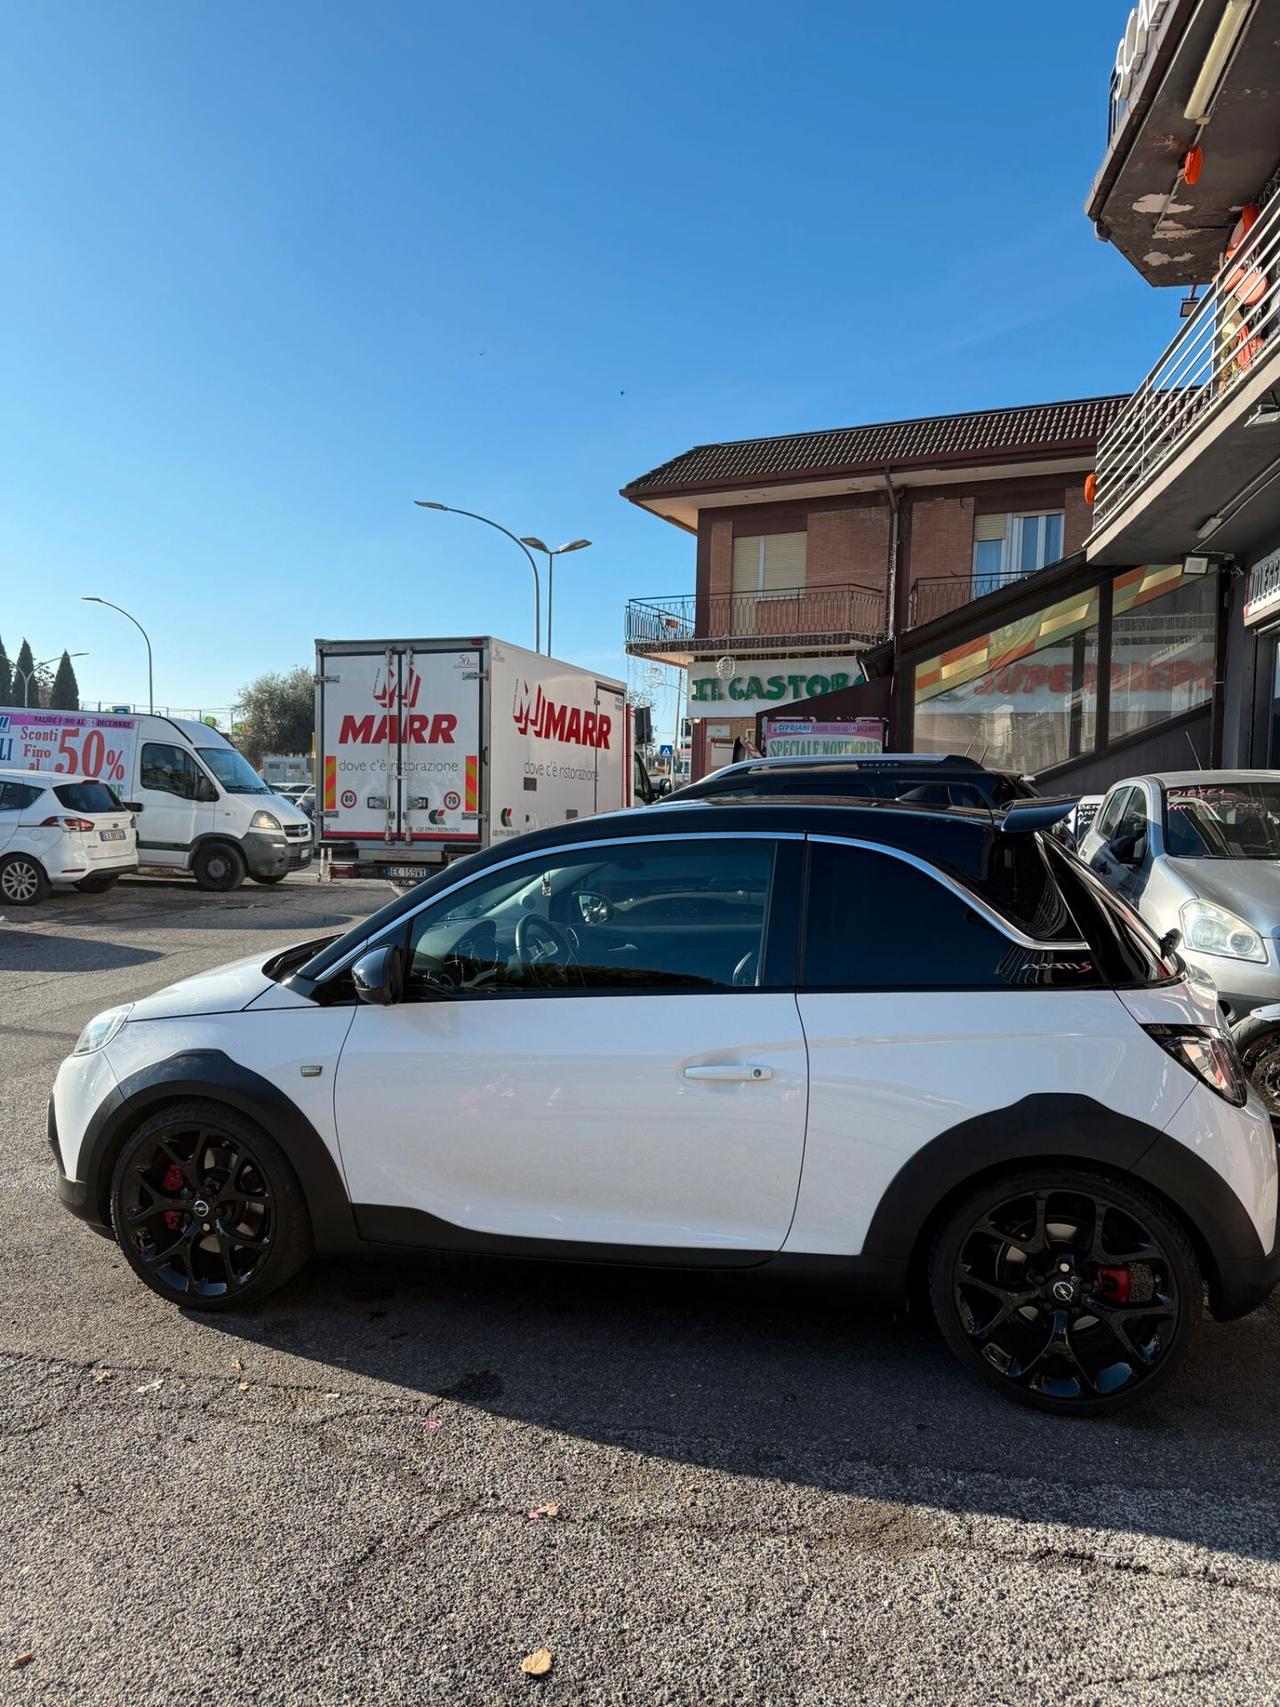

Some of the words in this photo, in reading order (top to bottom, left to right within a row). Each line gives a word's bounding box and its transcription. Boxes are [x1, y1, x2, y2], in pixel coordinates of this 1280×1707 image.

[20, 726, 58, 741] Sconti
[338, 714, 458, 744] MARR
[543, 701, 612, 750] MARR
[23, 744, 52, 758] Fino
[338, 758, 367, 772] dove
[390, 760, 459, 772] rtorazione
[524, 759, 544, 777] dove
